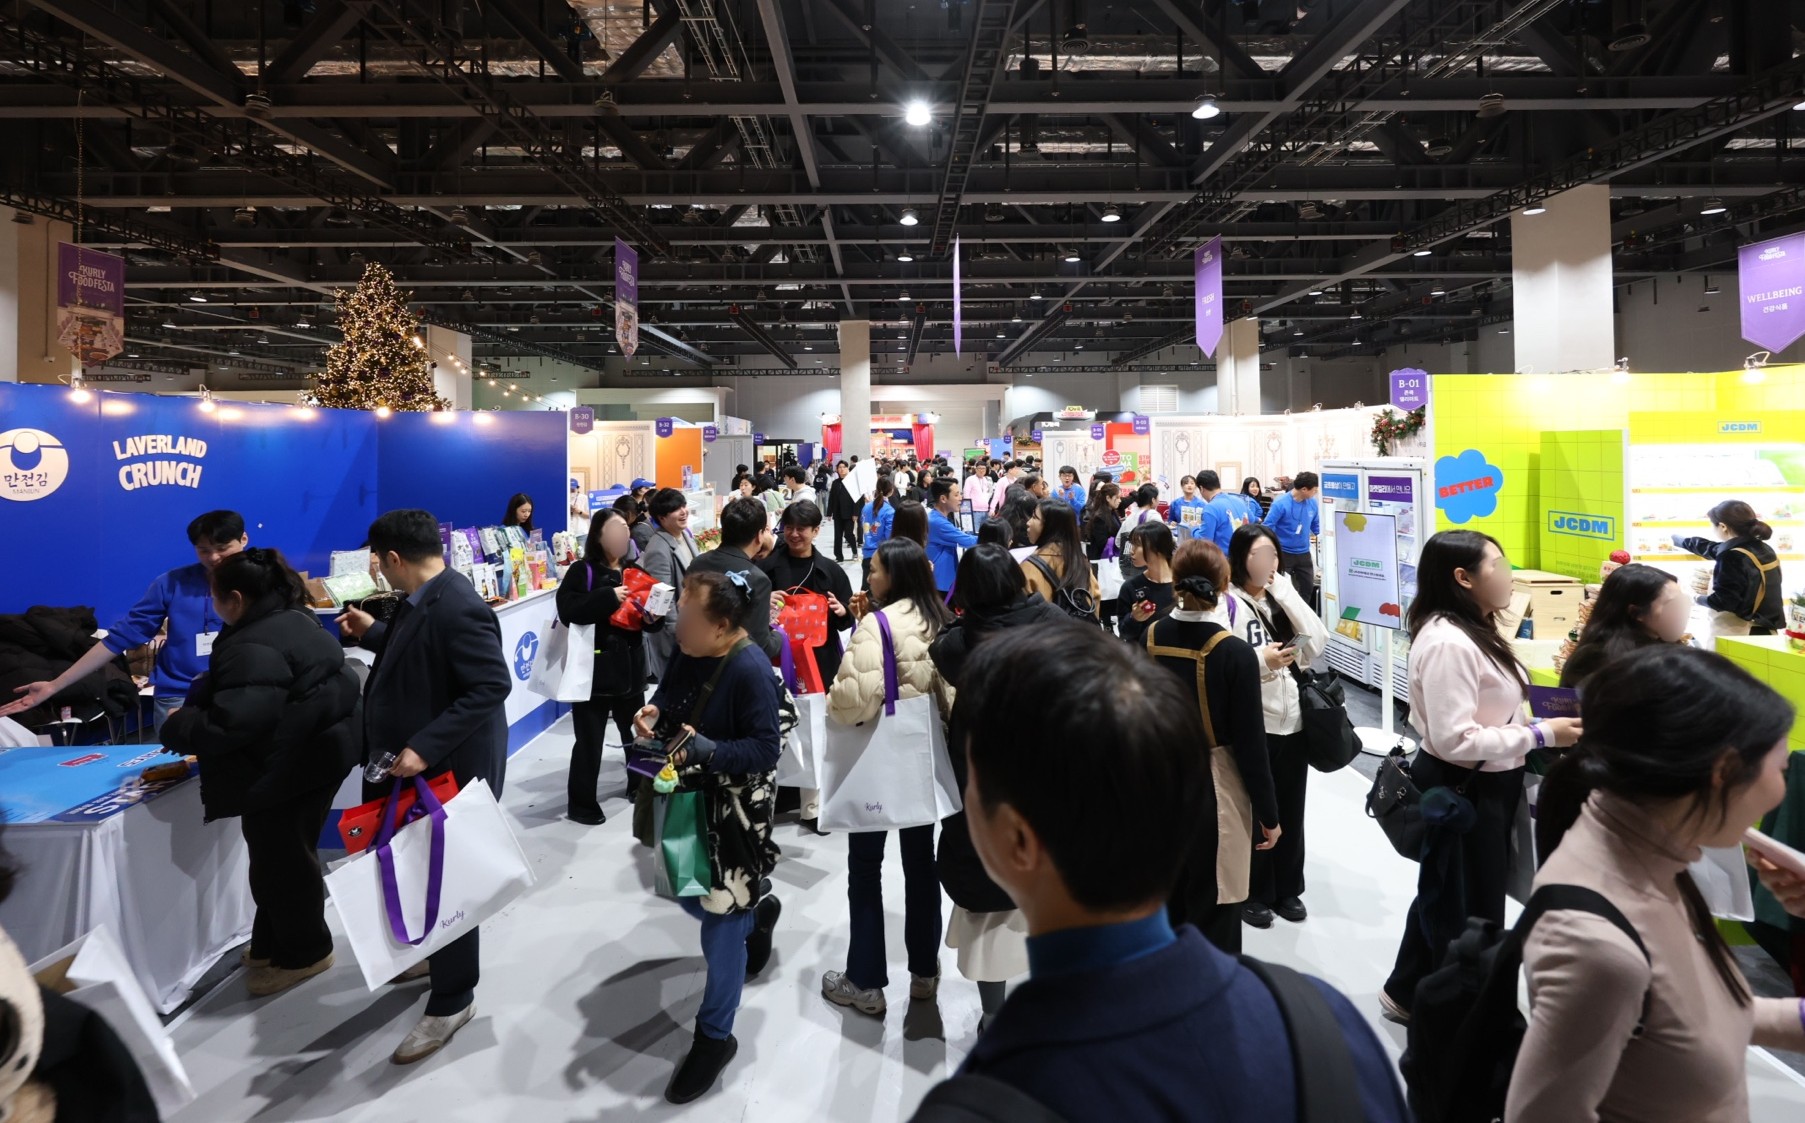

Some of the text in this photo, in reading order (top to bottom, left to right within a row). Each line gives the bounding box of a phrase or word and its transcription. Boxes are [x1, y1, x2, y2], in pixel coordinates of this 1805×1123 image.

[79, 265, 106, 278] KURLY
[1747, 286, 1802, 303] WELLBEING
[1398, 379, 1420, 388] B-01
[1721, 423, 1758, 431] JCDM
[112, 435, 207, 460] LAVERLAND
[4, 472, 48, 488] 만전김
[118, 461, 203, 491] CRUNCH
[1438, 476, 1494, 499] BETTER
[1554, 516, 1609, 534] JCDM
[1353, 559, 1380, 568] JCDM
[865, 801, 883, 813] Kurly
[440, 910, 466, 929] Kurly
